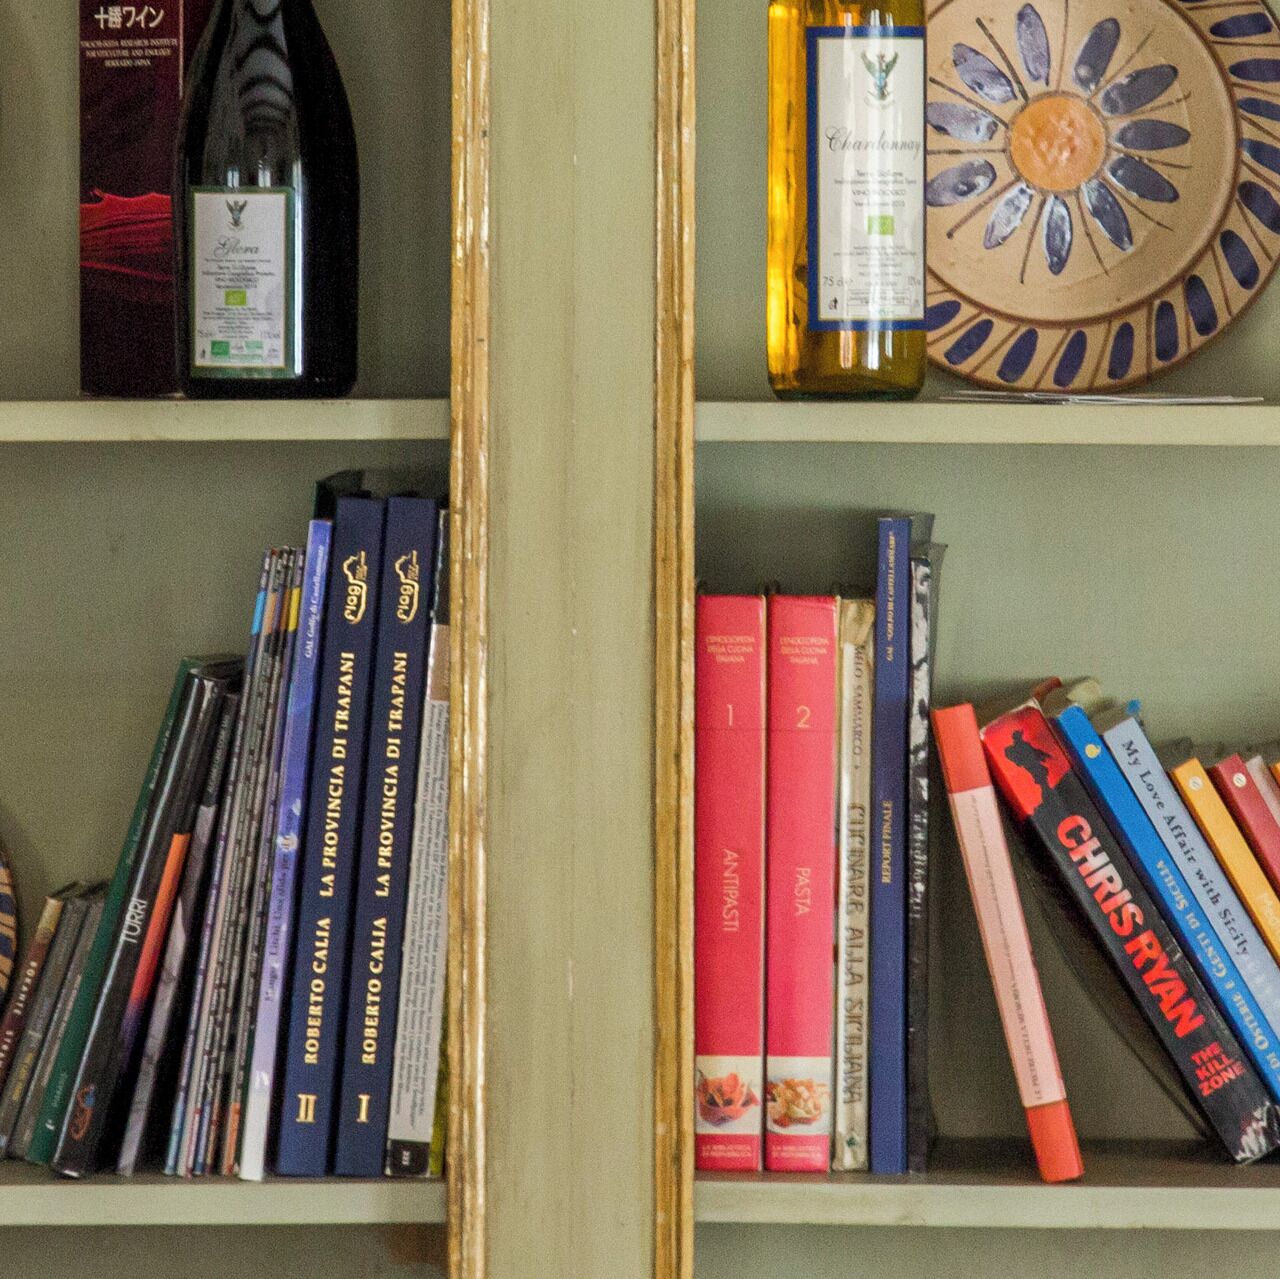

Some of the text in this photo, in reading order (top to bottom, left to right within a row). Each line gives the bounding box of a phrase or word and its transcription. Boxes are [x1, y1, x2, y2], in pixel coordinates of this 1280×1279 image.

[94, 5, 165, 29] 十勝ワイン
[825, 126, 921, 159] Chardonnay
[726, 704, 734, 726] 1
[796, 705, 811, 728] 2
[852, 684, 863, 755] SAMMARCO
[881, 800, 892, 840] FINALE
[303, 650, 354, 1065] ROBERTO CALIA LA PROVINCIA DI TRAPANI
[360, 649, 408, 1065] ROBERTO CALIA LA PROVINCIA DI TRAPANI
[1118, 739, 1144, 770] My
[1137, 769, 1169, 812] Love
[1162, 811, 1201, 867] Affair
[1192, 864, 1224, 907] with
[1213, 905, 1254, 960] Sicily
[721, 847, 741, 933] ANTIPASTI
[793, 866, 811, 916] PASTA
[118, 898, 149, 946] TURRI
[1057, 814, 1207, 1039] CHRIS RYAN
[842, 802, 866, 1104] CUCINARE ALLA SICILIANA
[1195, 1053, 1233, 1081] KILL
[1199, 1061, 1246, 1096] ZONE
[297, 1094, 317, 1123] II
